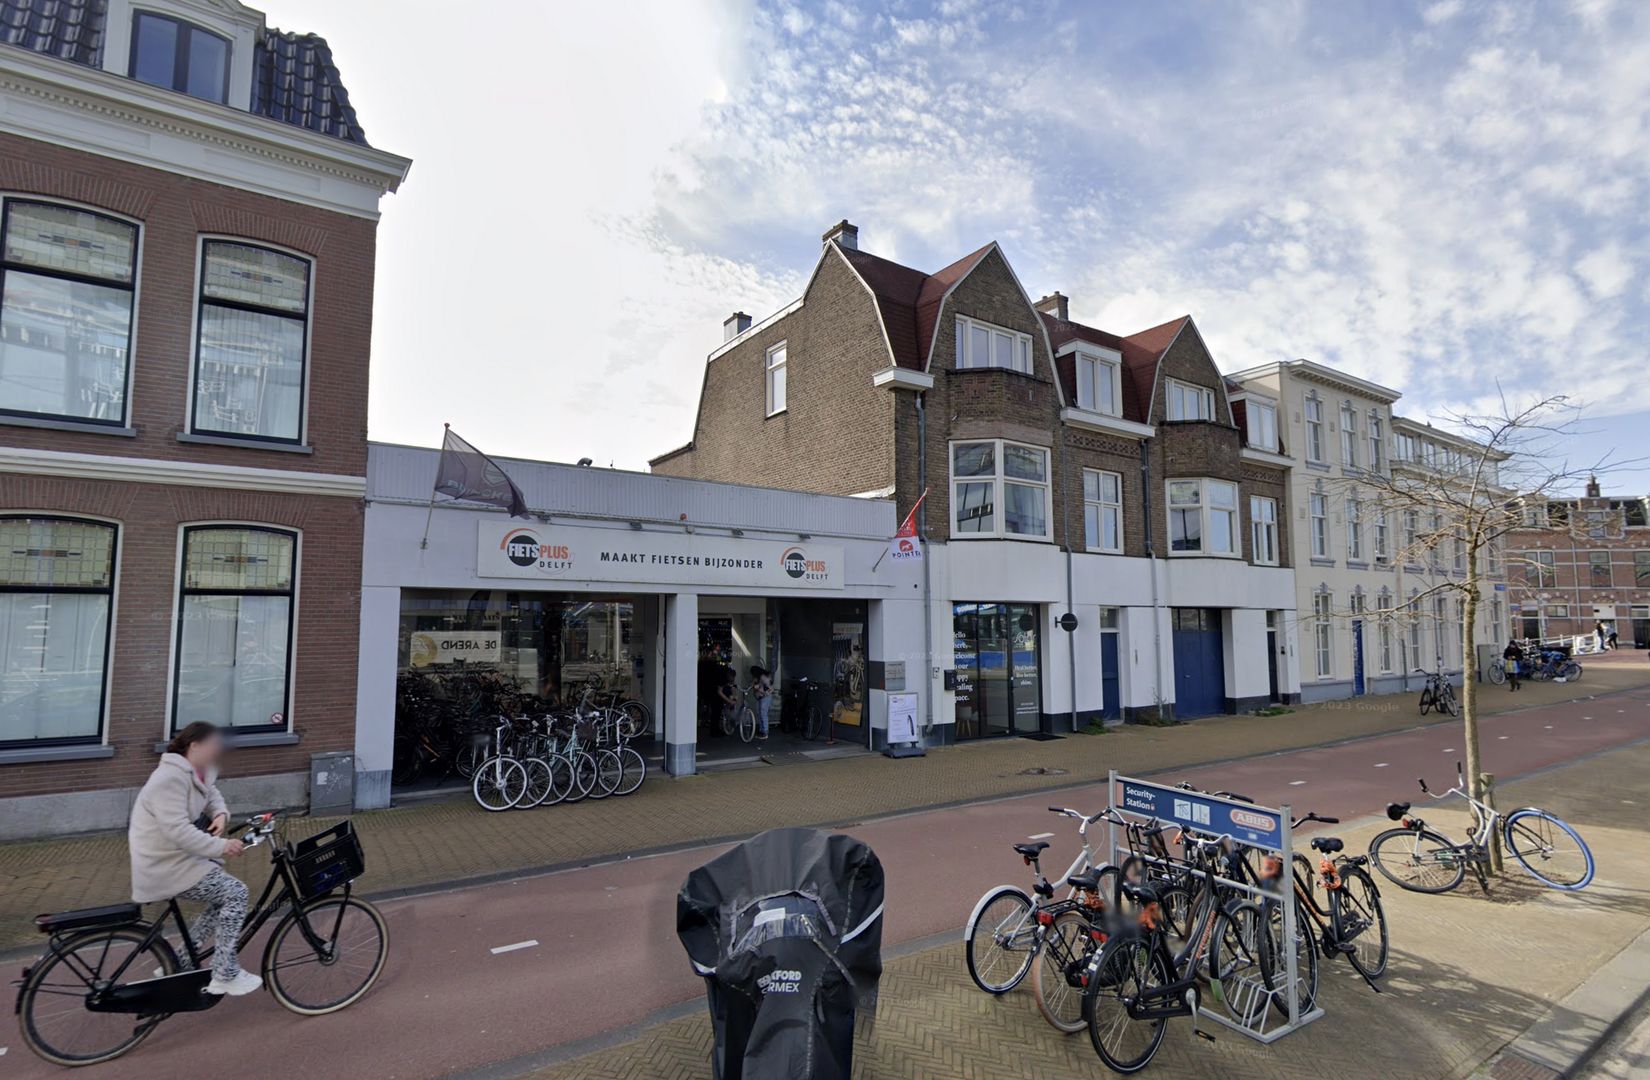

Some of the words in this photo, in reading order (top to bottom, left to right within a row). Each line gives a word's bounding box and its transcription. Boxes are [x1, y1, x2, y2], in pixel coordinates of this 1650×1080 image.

[539, 561, 573, 570] DELFT
[600, 551, 646, 564] MAAKT
[651, 554, 700, 566] FIETSEN
[704, 558, 764, 569] BIJZONDER
[1126, 786, 1156, 800] Security-
[1126, 797, 1151, 810] Station
[1235, 812, 1271, 829] ABUS
